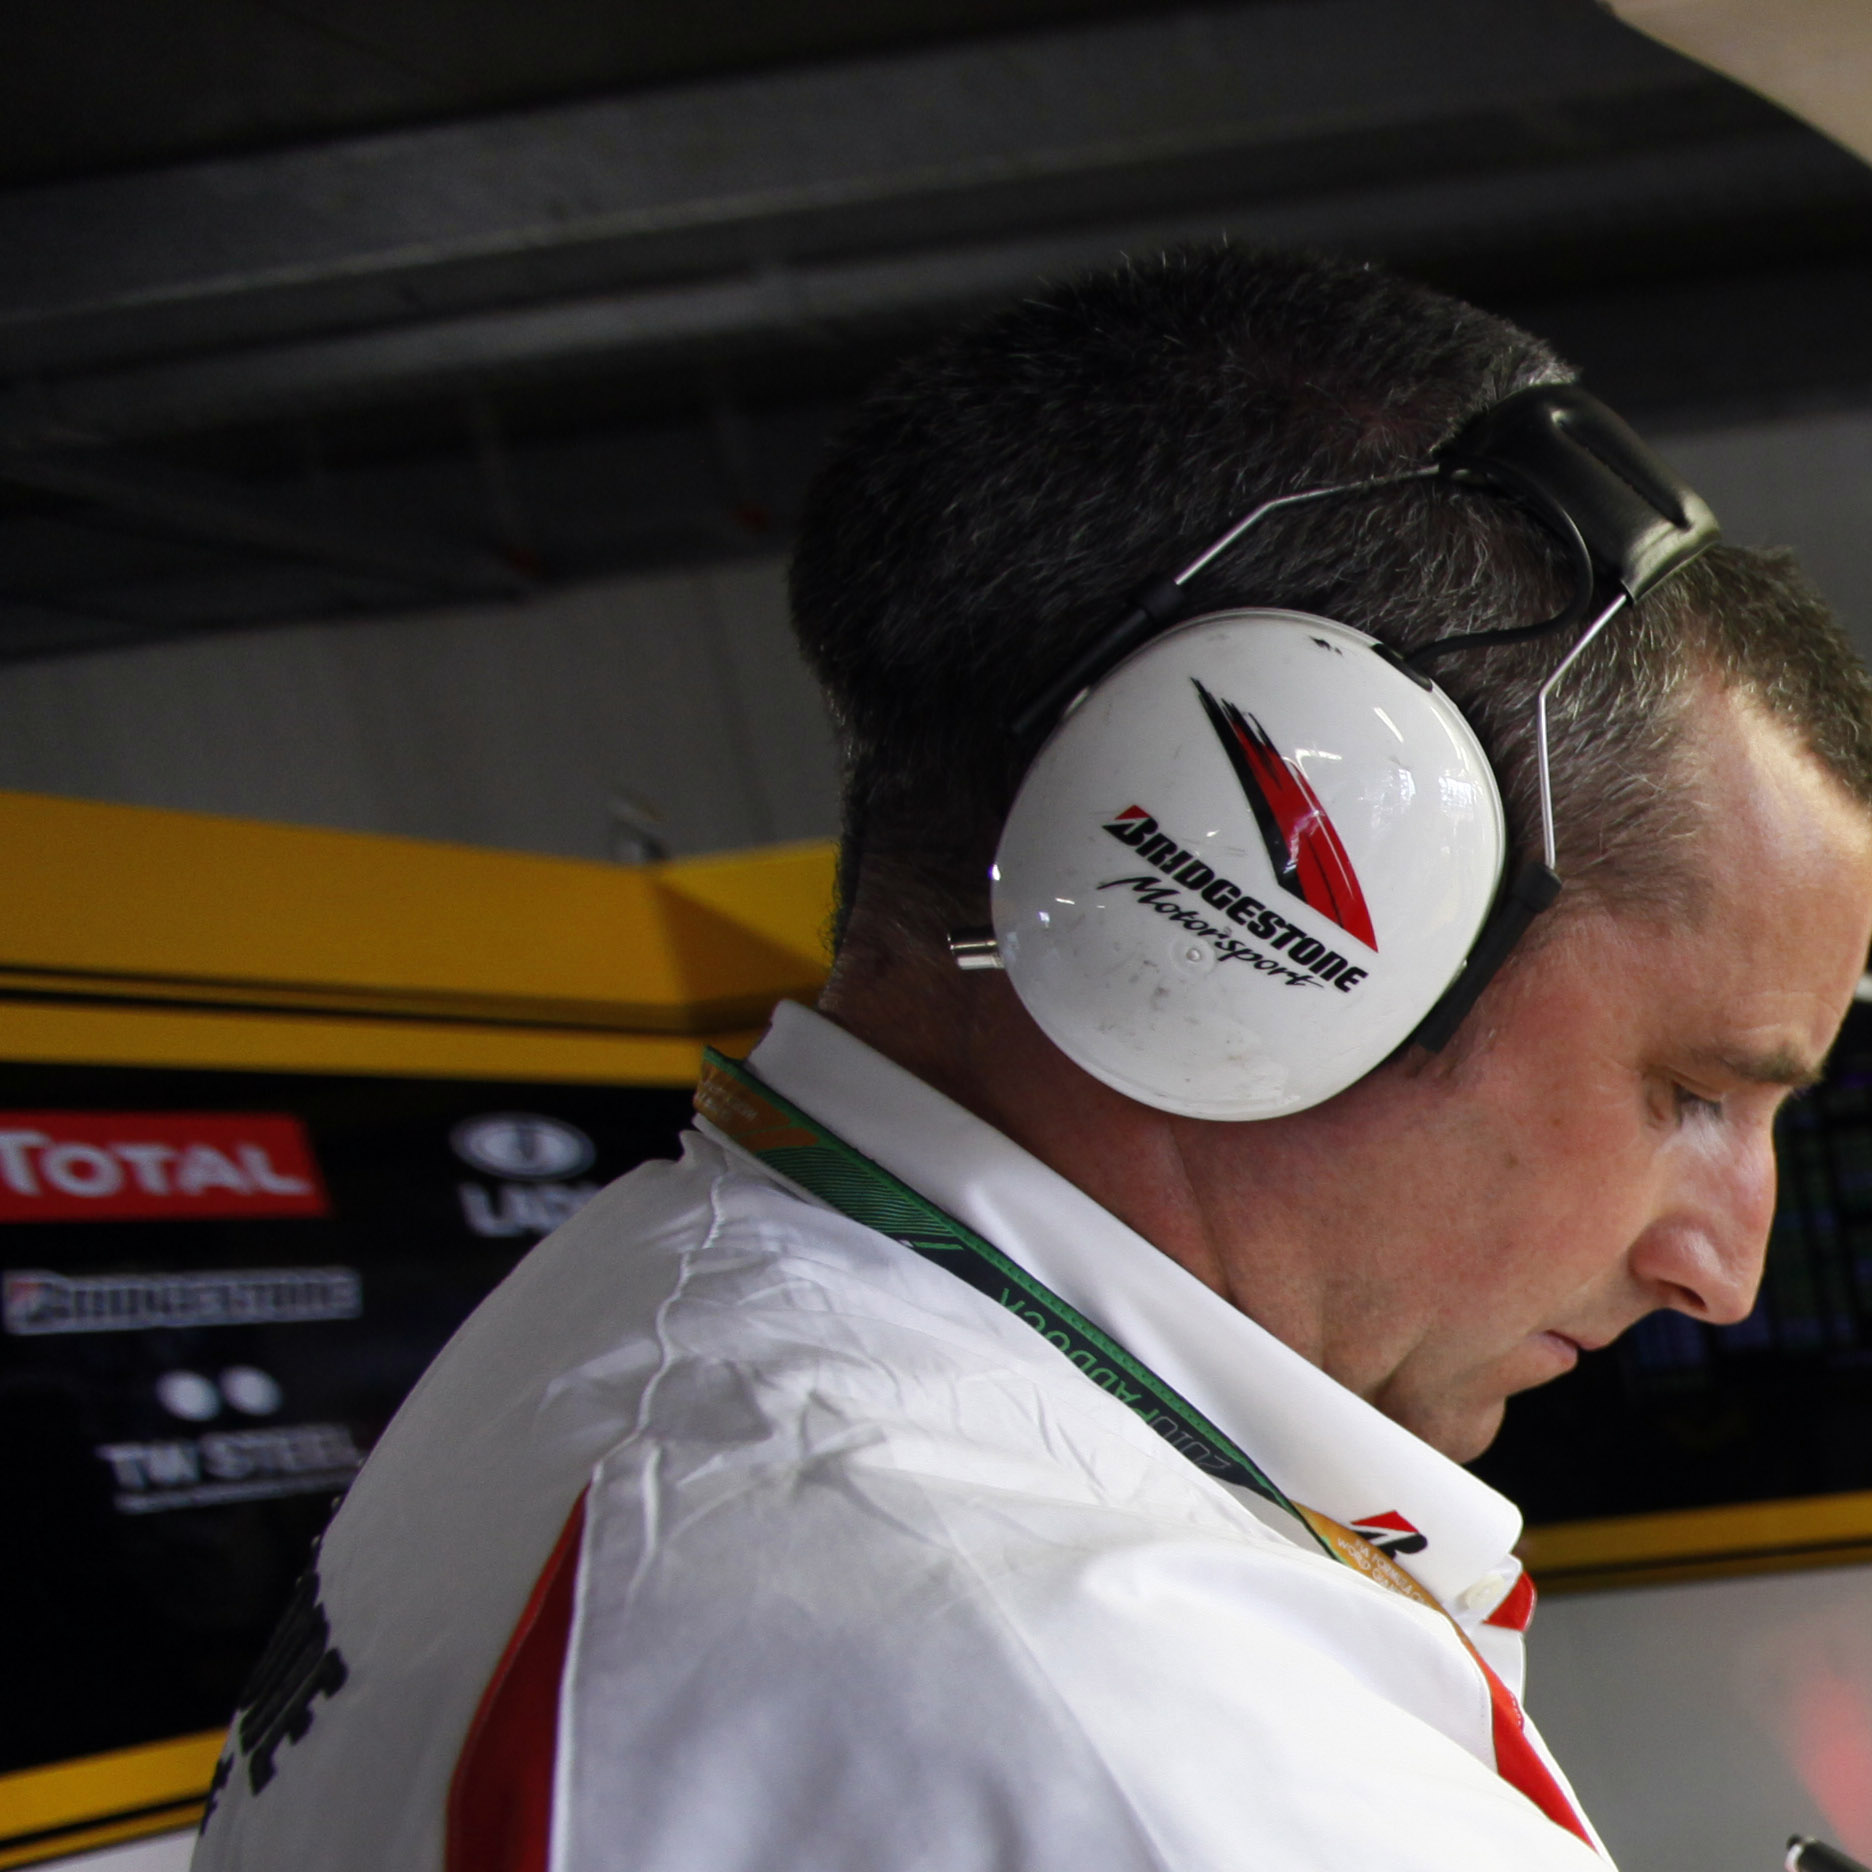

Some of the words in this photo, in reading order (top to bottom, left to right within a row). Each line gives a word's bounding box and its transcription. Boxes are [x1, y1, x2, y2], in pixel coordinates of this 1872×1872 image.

[1096, 876, 1324, 989] Motorsport
[1101, 804, 1368, 993] BRIDGESTONE
[0, 1129, 312, 1197] TOTAL
